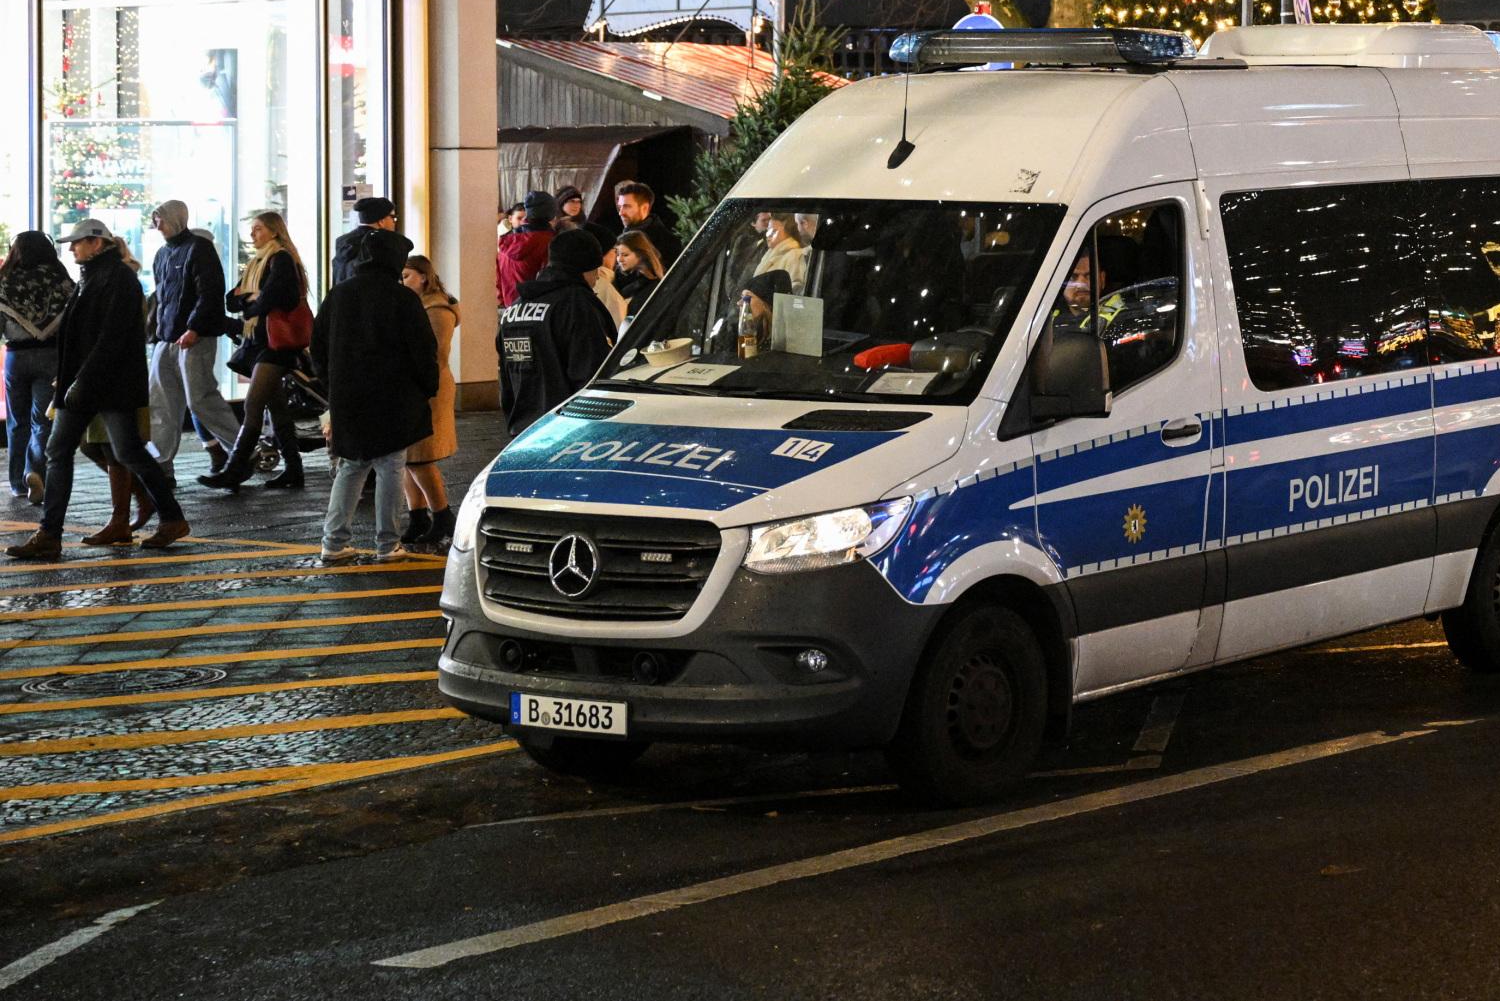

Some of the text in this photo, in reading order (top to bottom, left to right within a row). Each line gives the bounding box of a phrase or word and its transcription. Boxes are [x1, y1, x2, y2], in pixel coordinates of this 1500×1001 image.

[500, 302, 551, 325] POLIZEI
[504, 340, 531, 352] POLIZEI
[549, 440, 737, 472] POLIZEI
[782, 439, 825, 461] 14
[1288, 464, 1379, 512] POLIZEI
[528, 699, 613, 730] B 31683
